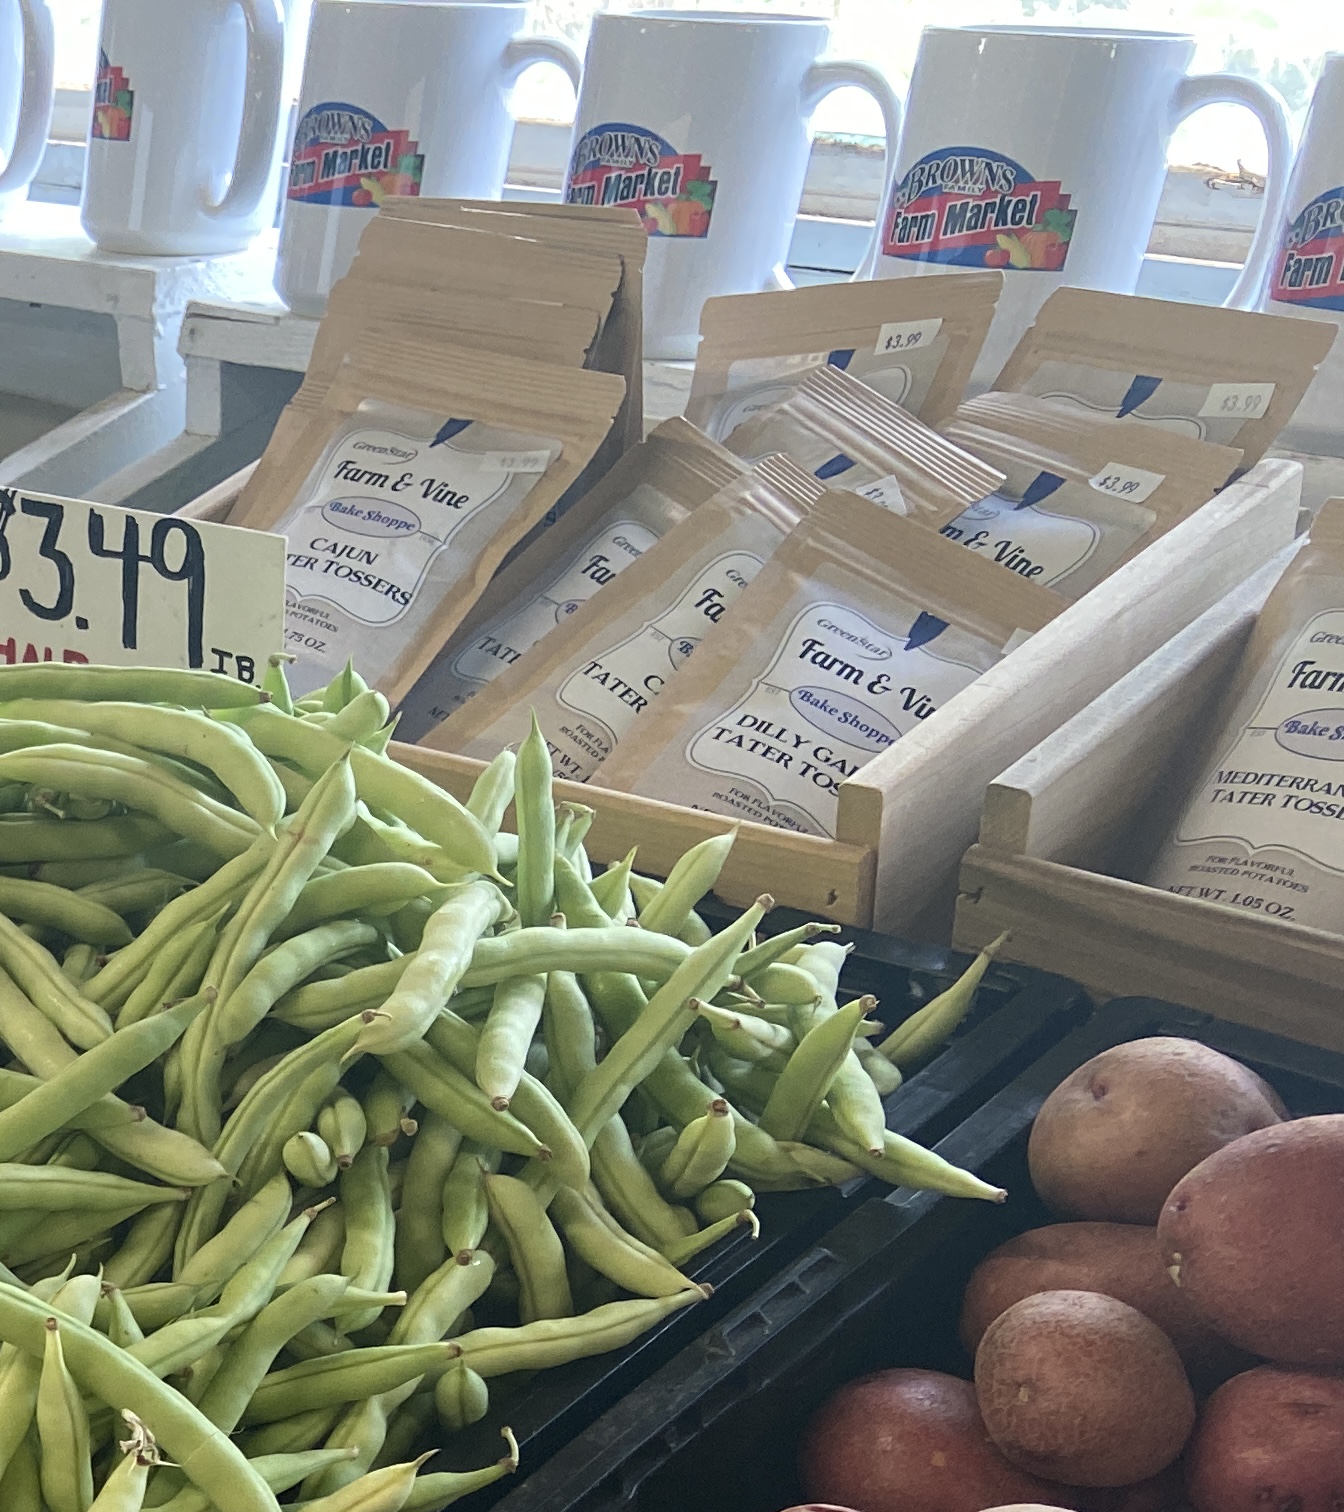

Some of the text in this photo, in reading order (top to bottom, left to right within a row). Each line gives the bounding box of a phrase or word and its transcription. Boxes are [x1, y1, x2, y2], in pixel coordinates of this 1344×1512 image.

[320, 140, 392, 182] Market
[601, 165, 683, 206] Market
[943, 184, 984, 194] FAMILY
[890, 193, 1039, 244] Farm Market
[1278, 251, 1334, 289] Farm
[885, 331, 922, 351] $3.99
[1221, 394, 1262, 412] $3.99
[334, 460, 470, 509] Farm & Vine
[1098, 475, 1140, 495] $3.99
[329, 501, 416, 532] Bake Shoppe
[309, 537, 379, 566] CAJUN
[995, 540, 1044, 580] Vine
[322, 559, 413, 606] TOSSERS
[799, 638, 864, 686] Farm
[867, 673, 892, 695] &
[582, 660, 649, 714] TATER
[798, 689, 839, 717] Bake
[736, 714, 811, 749] DILLY
[1285, 720, 1330, 736] Bake
[712, 727, 794, 770] TATER
[1210, 788, 1276, 807] TATER
